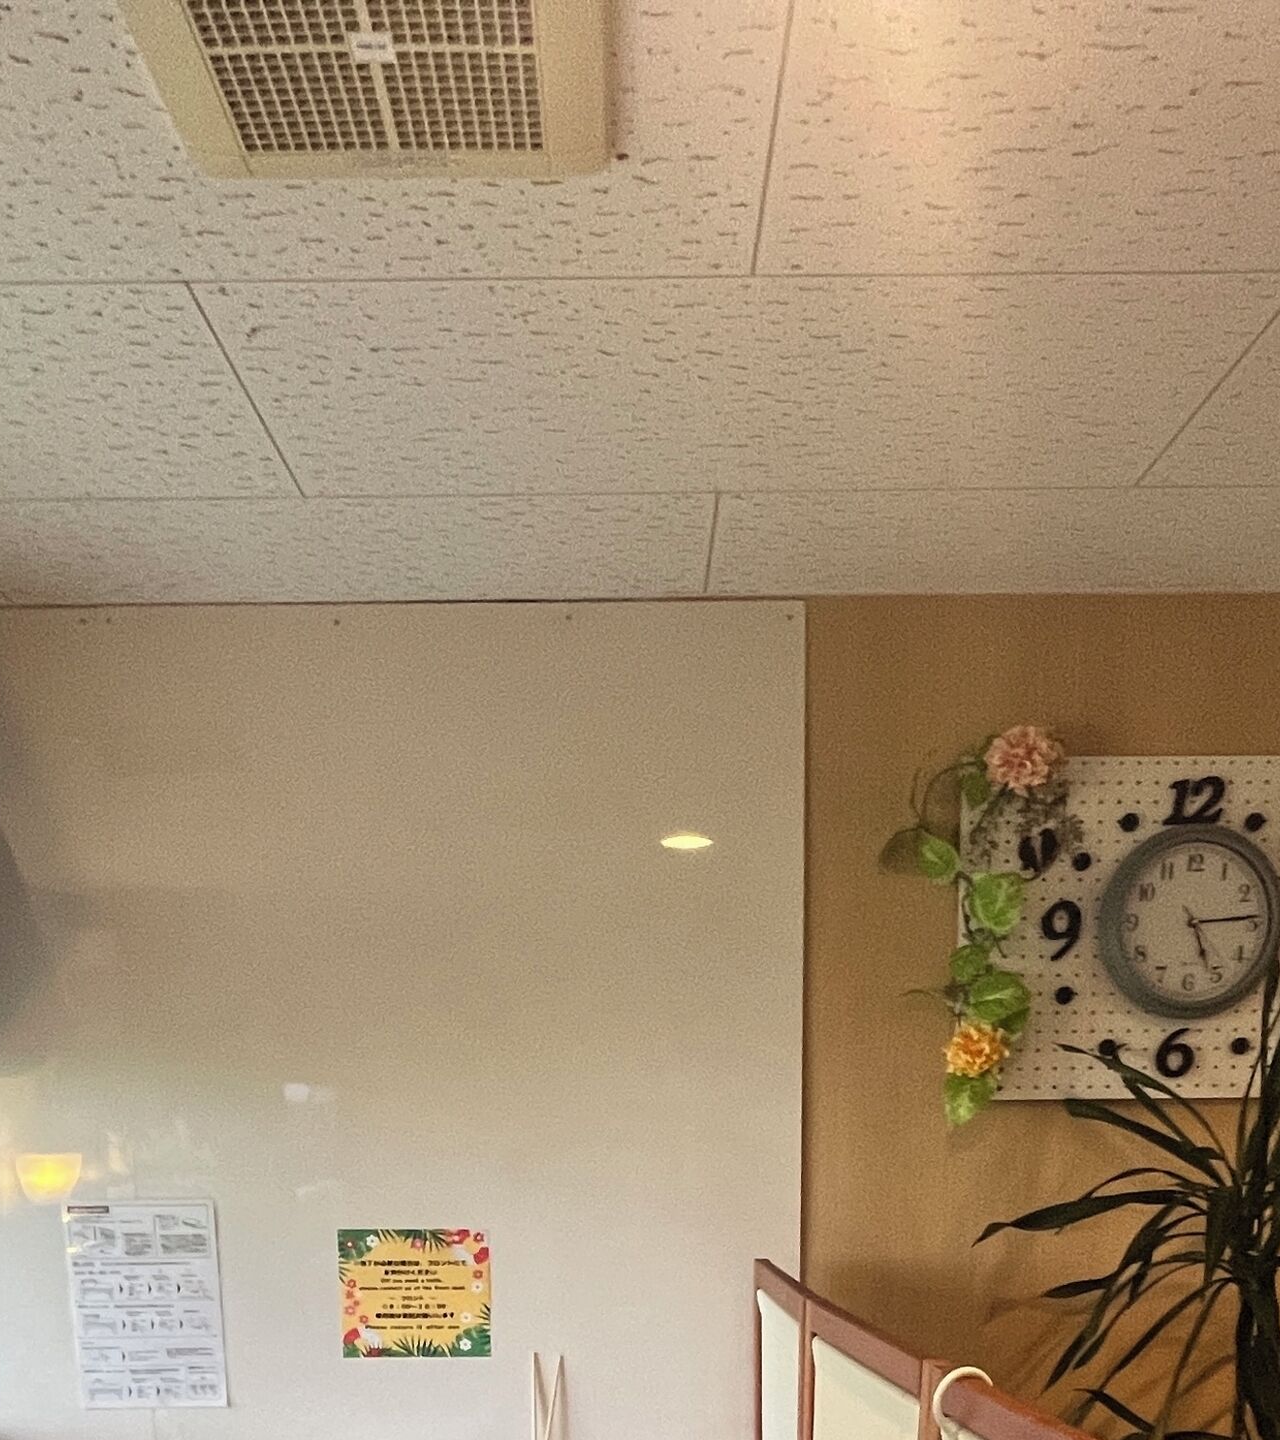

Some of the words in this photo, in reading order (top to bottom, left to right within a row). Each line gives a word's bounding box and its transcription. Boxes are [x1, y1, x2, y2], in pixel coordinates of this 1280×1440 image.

[1163, 775, 1225, 826] 12
[1160, 861, 1174, 881] 11
[1187, 853, 1206, 873] 12
[1138, 882, 1156, 902] 10
[1238, 883, 1251, 903] 2
[1041, 900, 1083, 961] 9
[1125, 913, 1139, 932] 9
[1181, 973, 1195, 991] 6
[1210, 965, 1223, 984] 5
[1155, 1028, 1195, 1078] 6
